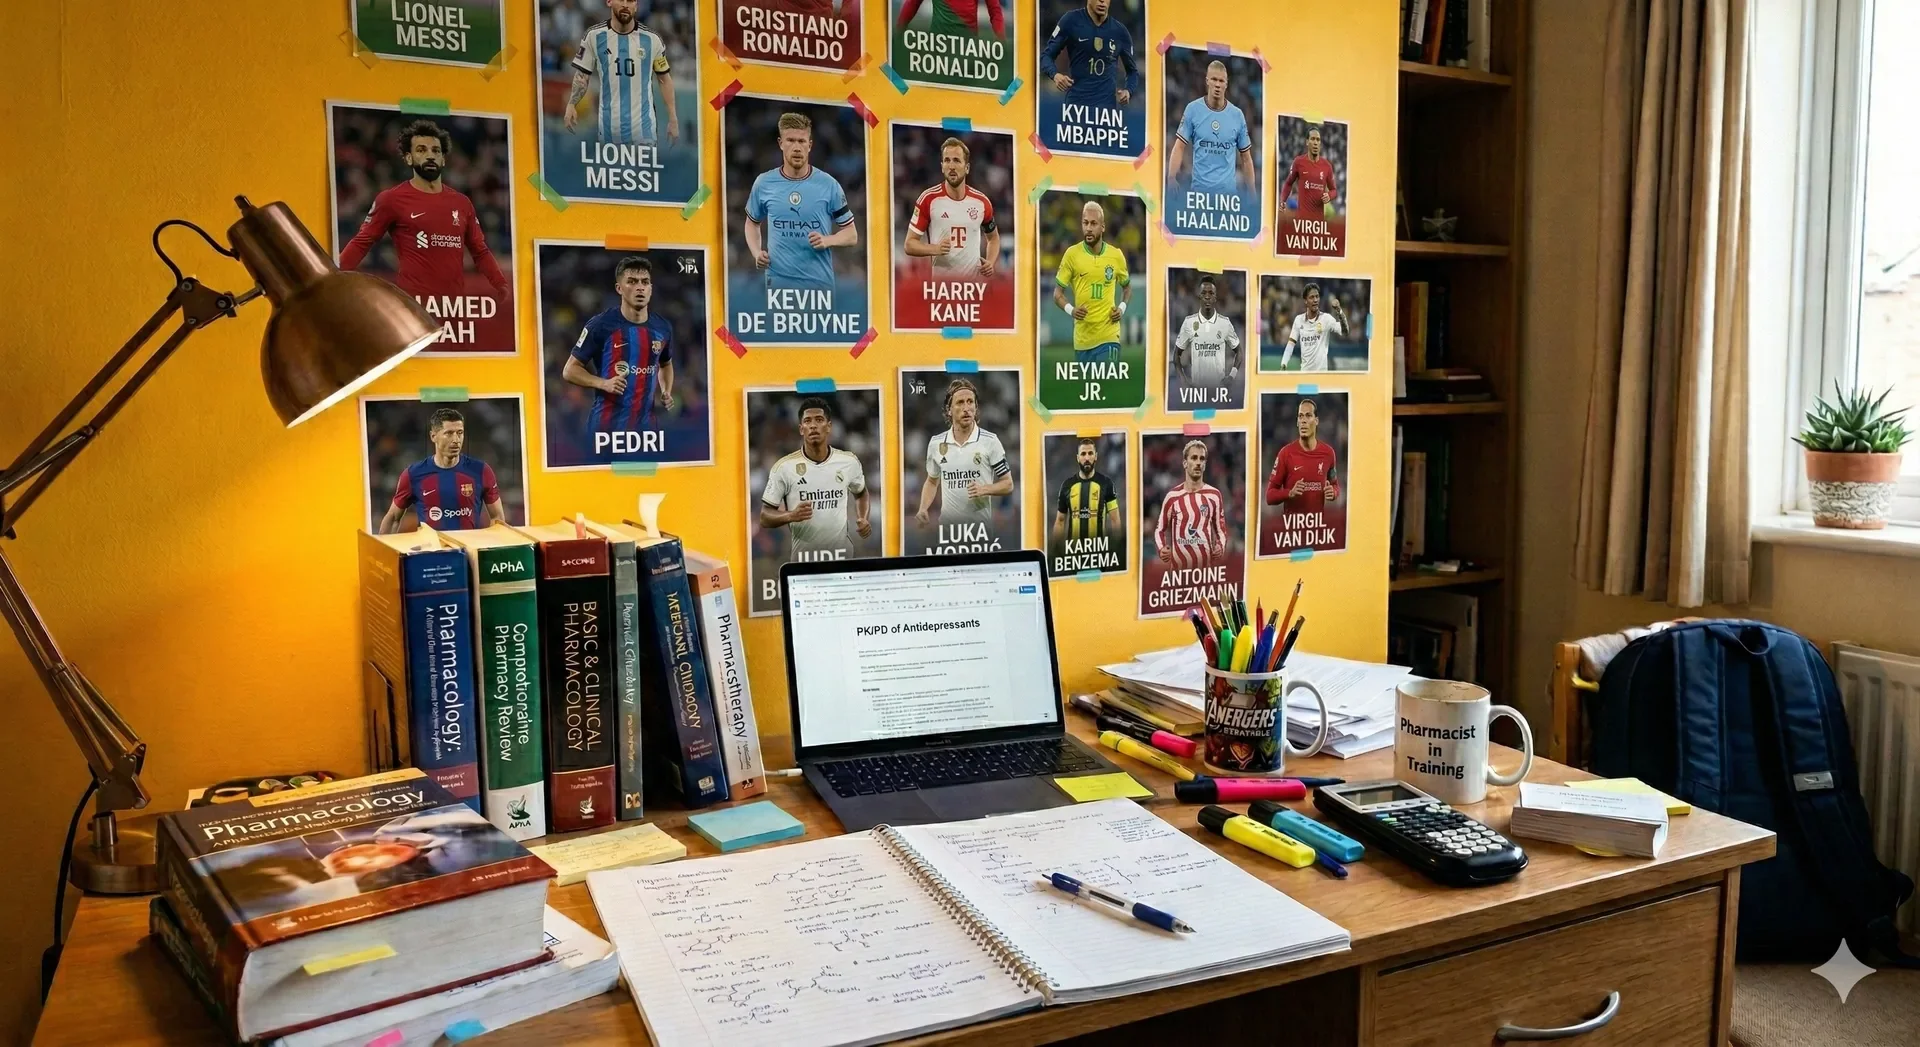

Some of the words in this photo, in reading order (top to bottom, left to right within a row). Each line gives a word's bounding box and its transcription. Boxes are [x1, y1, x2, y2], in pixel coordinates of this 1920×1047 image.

[391, 0, 471, 30] LIONEL
[736, 6, 848, 40] CRISTIANO
[396, 25, 467, 52] MESSI
[743, 30, 844, 62] RONALDO
[903, 29, 1004, 61] CRISTIANO
[614, 58, 635, 77] 10
[909, 52, 999, 82] RONALDO
[1088, 57, 1105, 76] 10
[1062, 103, 1123, 127] KYLIAN
[1056, 124, 1128, 149] MBAPPÉ
[580, 141, 664, 169] LIONEL
[586, 167, 659, 193] MESSI
[1186, 191, 1240, 212] ERLING
[773, 220, 821, 229] ETIHAD
[1176, 211, 1250, 232] HAALAND
[1293, 218, 1330, 235] VIRGIL
[1285, 234, 1309, 249] VAN
[1312, 236, 1338, 251] DIJK
[767, 288, 831, 310] KEVIN
[923, 281, 987, 301] HARRY
[1090, 283, 1103, 300] 10
[738, 312, 766, 333] DE
[773, 313, 860, 334] BRUYNE
[930, 303, 981, 322] KANE
[1055, 361, 1129, 380] NEYMAR
[1079, 382, 1106, 401] JR.
[1179, 387, 1207, 403] VINI
[1211, 387, 1232, 402] JR.
[595, 430, 665, 454] PEDRI
[942, 469, 981, 481] Emirates
[799, 489, 844, 501] Emirates
[1282, 512, 1327, 530] VIRGIL
[939, 522, 989, 544] LUKA
[1274, 531, 1302, 548] VAN
[1305, 528, 1336, 546] DIJK
[1065, 536, 1109, 555] KARIM
[490, 561, 525, 574] APhA
[1054, 552, 1119, 572] BENZEMA
[1160, 565, 1226, 588] ANTOINE
[1148, 582, 1238, 608] GRIEZMANN
[582, 601, 598, 651] BASIC
[856, 624, 889, 637] PK/PD
[891, 624, 901, 634] of
[902, 617, 981, 634] Antidepressants
[493, 625, 511, 702] Pharmacy
[584, 656, 599, 668] &
[439, 603, 464, 752] Pharmacology:
[563, 603, 583, 752] PHARMACOLOGY
[585, 672, 602, 752] CLINICAL
[497, 705, 515, 762] Review
[1400, 717, 1476, 740] Pharmacist
[1428, 742, 1442, 757] in
[1407, 756, 1464, 779] Training
[203, 788, 425, 841] Pharmacology
